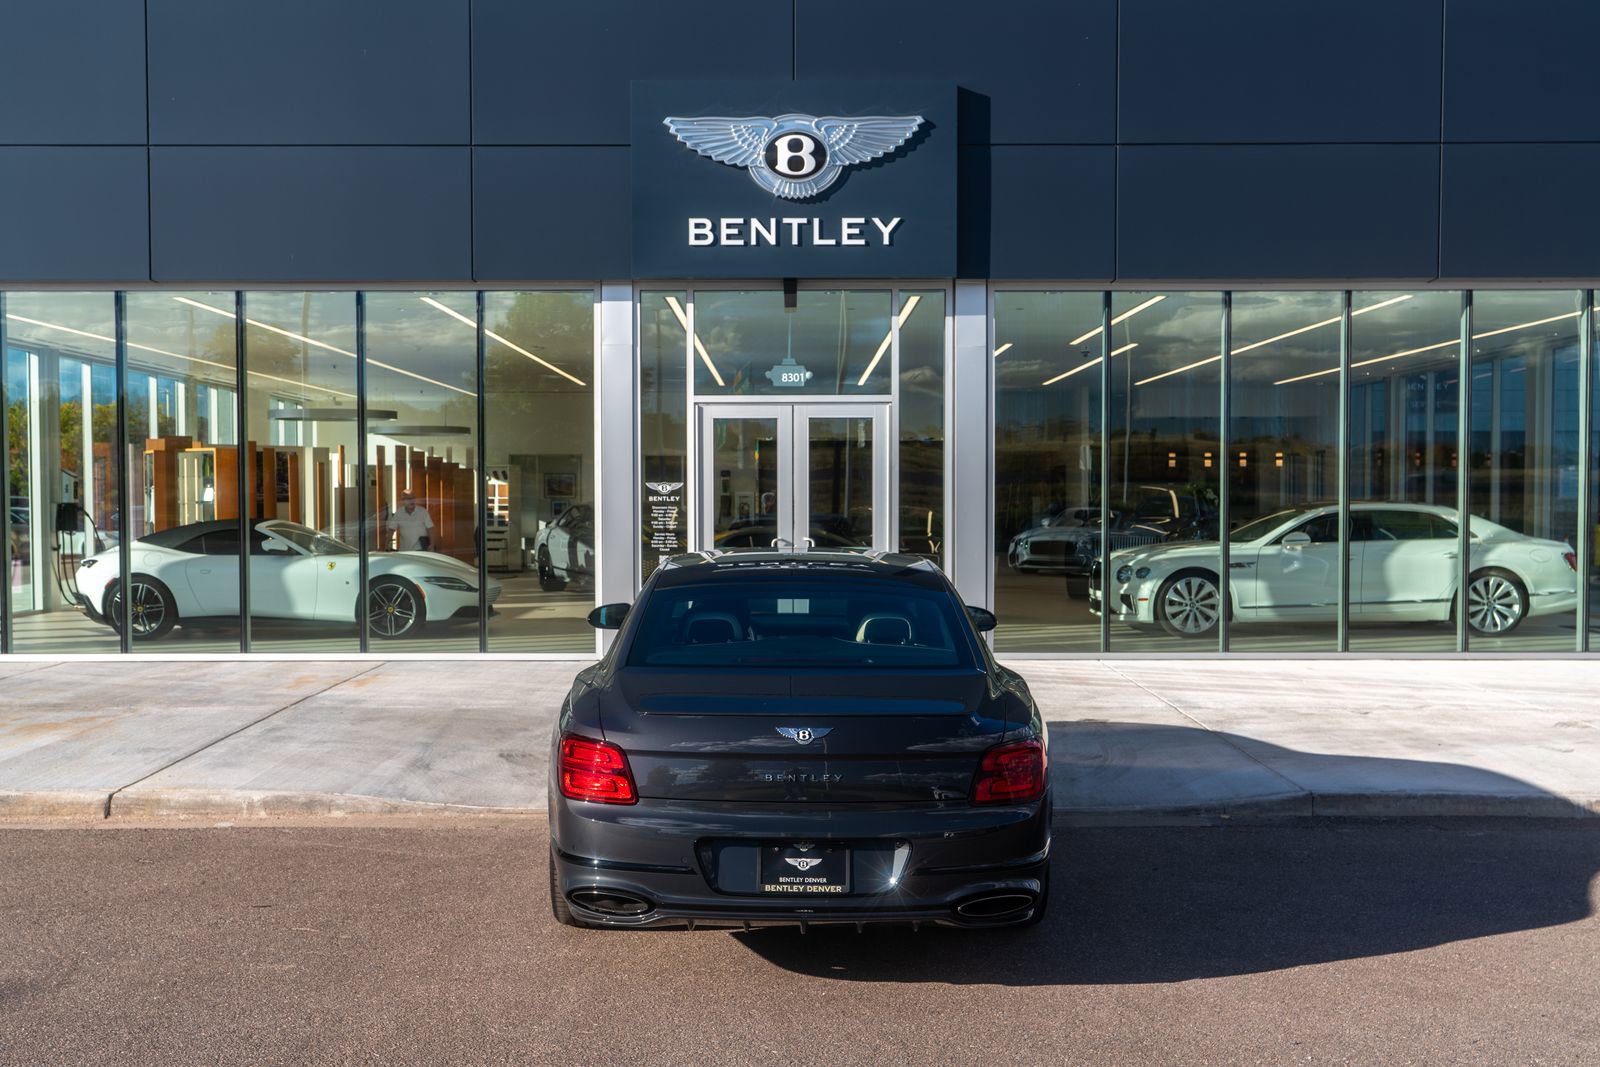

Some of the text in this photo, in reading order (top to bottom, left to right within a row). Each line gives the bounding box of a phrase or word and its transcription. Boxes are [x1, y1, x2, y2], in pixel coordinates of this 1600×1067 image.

[774, 134, 817, 176] B
[688, 217, 901, 246] BENTLEY
[781, 372, 804, 383] 8301
[765, 774, 843, 782] BENTLEY
[764, 884, 843, 893] BENTLEY DENVER
